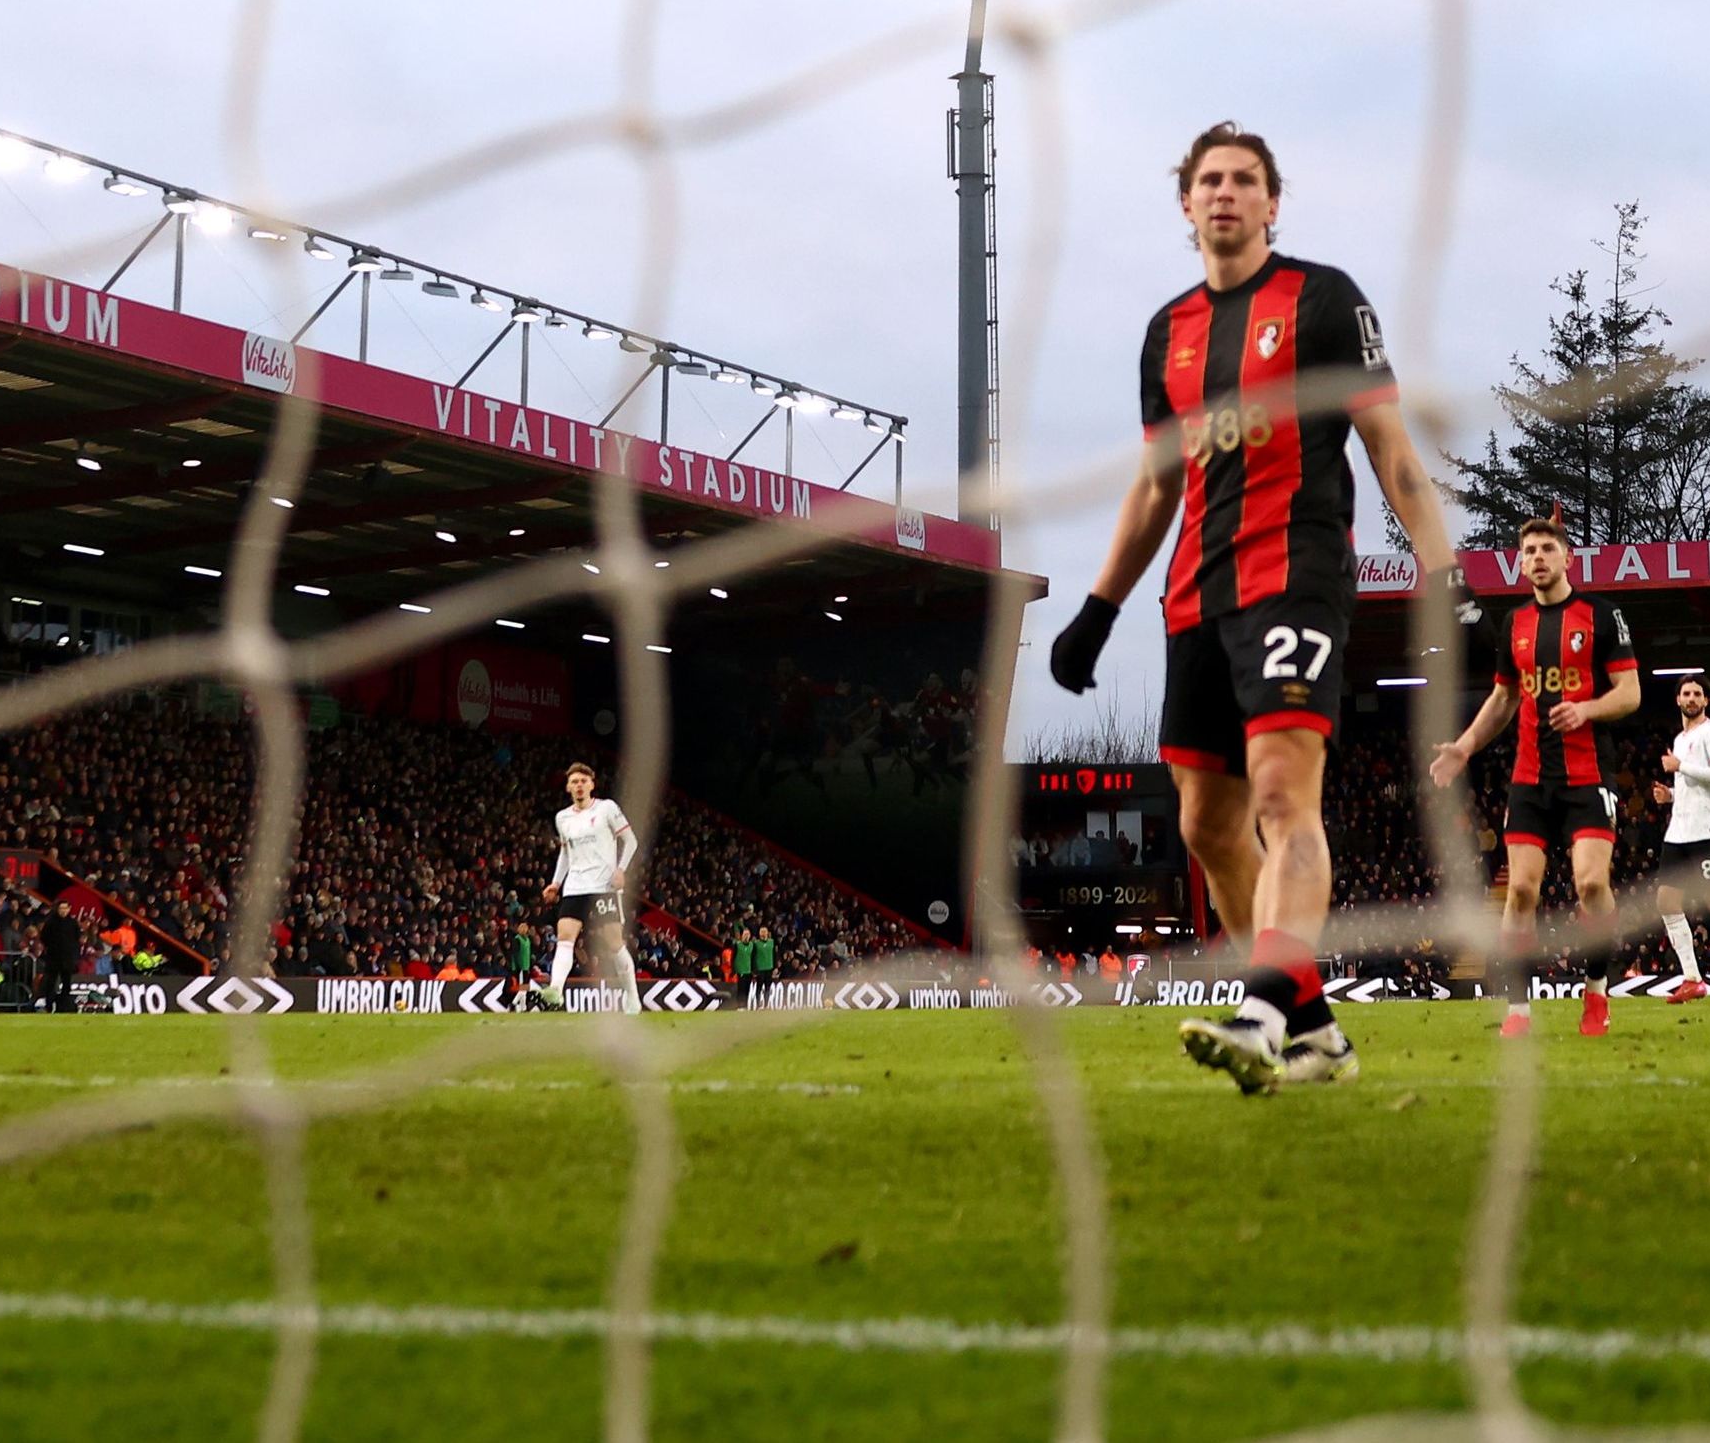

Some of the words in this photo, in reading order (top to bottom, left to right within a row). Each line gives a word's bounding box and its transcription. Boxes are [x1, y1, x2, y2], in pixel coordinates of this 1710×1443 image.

[245, 335, 293, 393] Vitality
[432, 385, 632, 475] VITALITY
[658, 446, 812, 520] STADIUM
[1263, 625, 1333, 682] 27
[1520, 666, 1583, 699] bj88
[595, 898, 618, 915] 84
[58, 974, 167, 1015] bro
[317, 978, 447, 1014] UMBRO.CO.UK
[565, 979, 628, 1013] umbr
[909, 982, 961, 1010] umbro
[970, 982, 1018, 1009] umbro
